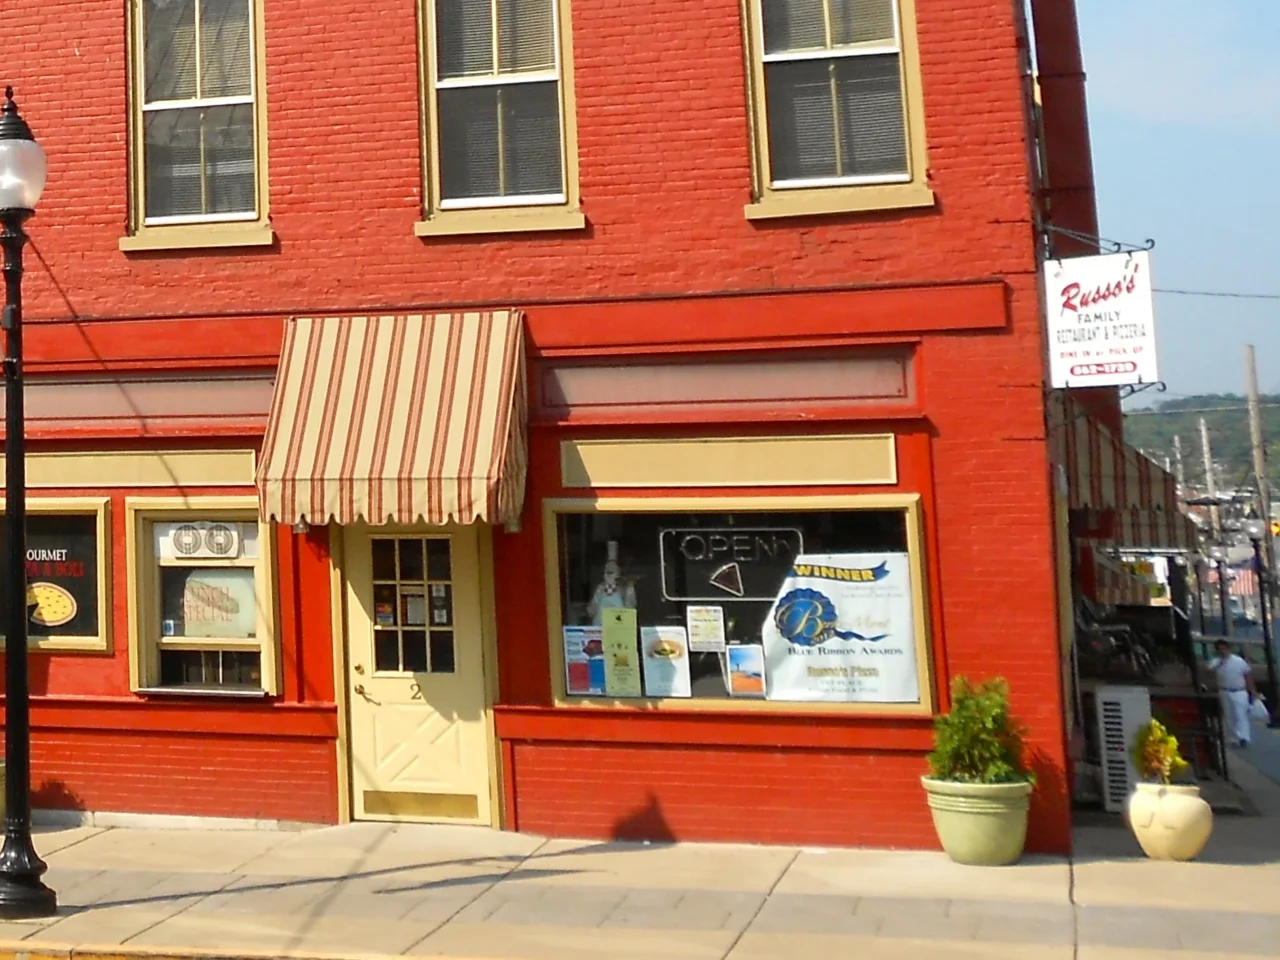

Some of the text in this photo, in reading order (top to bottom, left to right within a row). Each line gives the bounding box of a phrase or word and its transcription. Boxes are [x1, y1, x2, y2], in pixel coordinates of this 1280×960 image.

[1060, 263, 1140, 317] Russo's
[1077, 310, 1122, 324] FAMILY
[26, 548, 68, 562] OURMET
[680, 534, 777, 561] OPEN
[793, 564, 876, 581] WINNER
[184, 586, 230, 603] LUNCH
[181, 605, 233, 622] SPECIAL
[818, 646, 856, 656] RIBBON
[860, 646, 904, 656] AWARDS
[410, 683, 422, 700] 2
